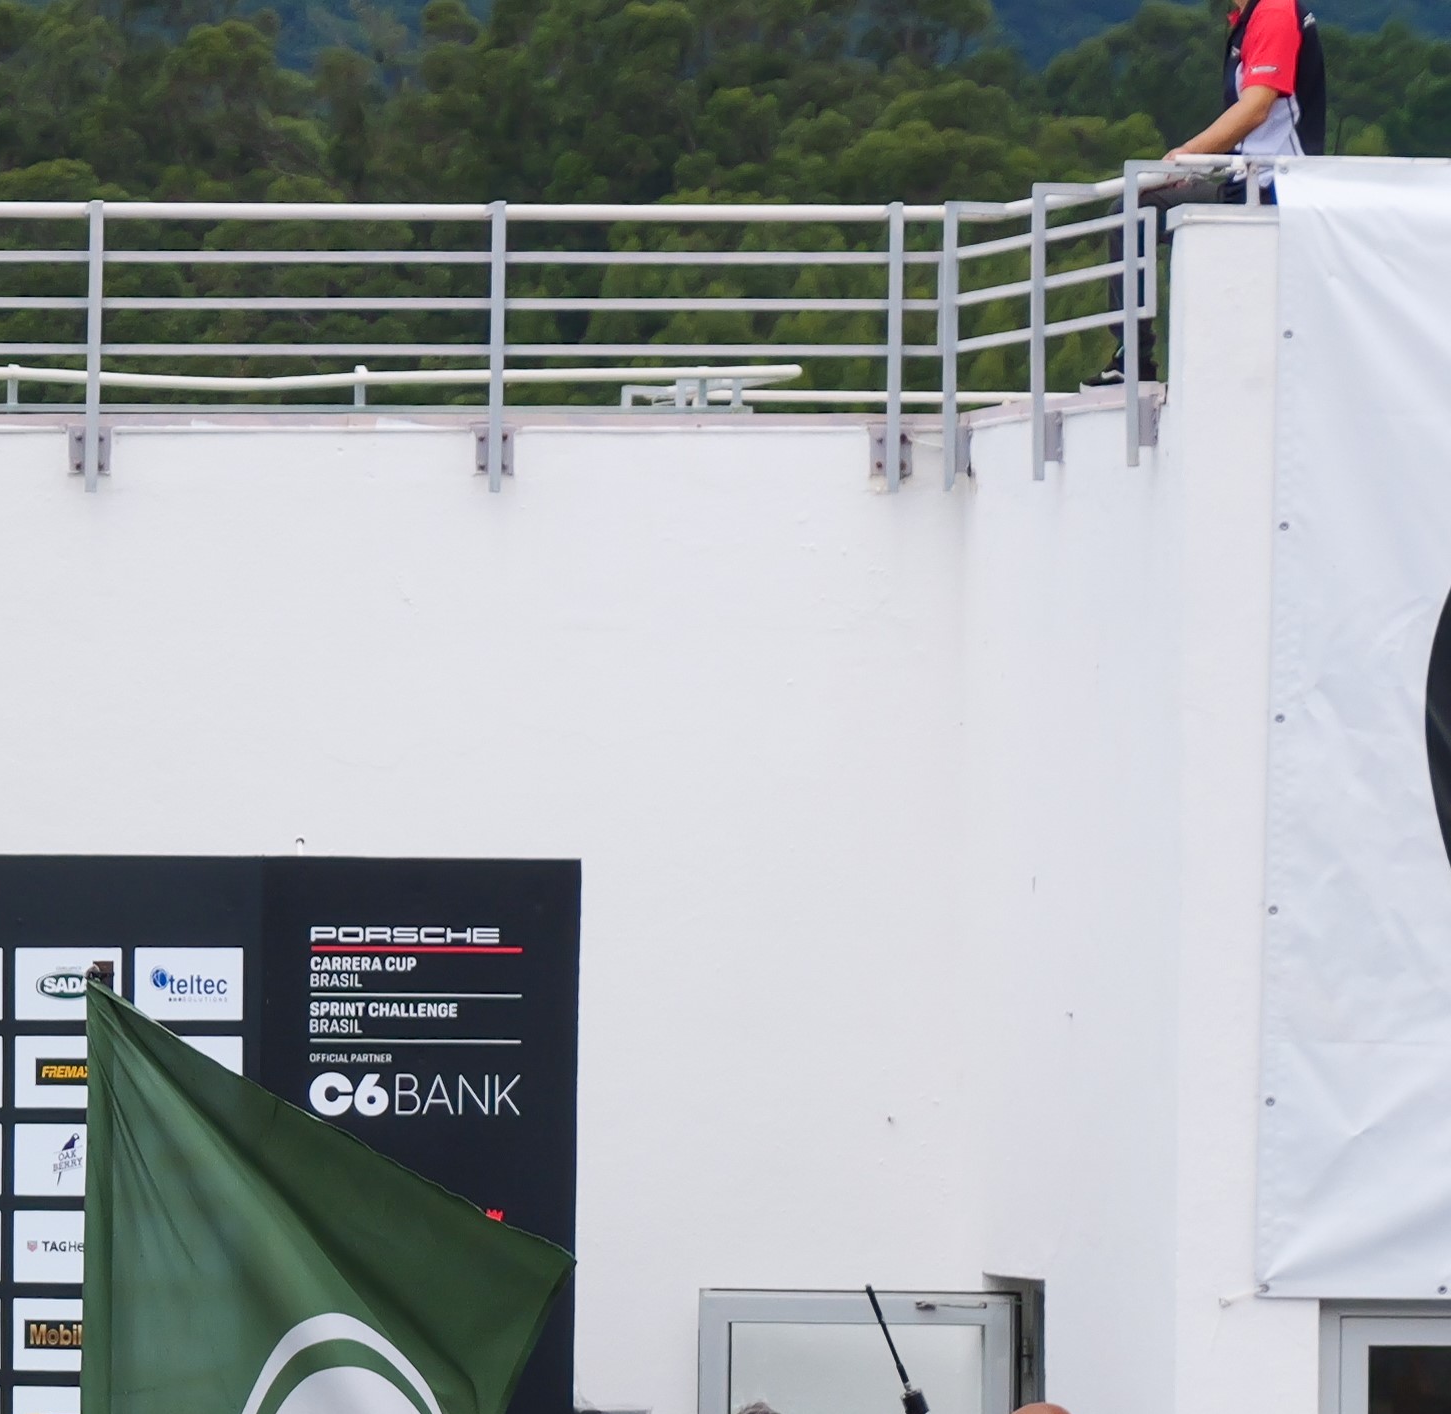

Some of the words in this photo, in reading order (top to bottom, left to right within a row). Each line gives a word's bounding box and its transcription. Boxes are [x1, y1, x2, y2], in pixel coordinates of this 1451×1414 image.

[310, 927, 499, 943] PORSCHE
[310, 957, 382, 971] CARRERA
[385, 957, 416, 971] CUP
[169, 973, 227, 994] teltec
[310, 973, 364, 987] BRASIL
[310, 1002, 365, 1017] SPRINT
[368, 1002, 457, 1018] CHALLENGE
[310, 1019, 362, 1033] BRASIL
[310, 1053, 348, 1063] OFFICIAL
[351, 1054, 392, 1063] PARTNER
